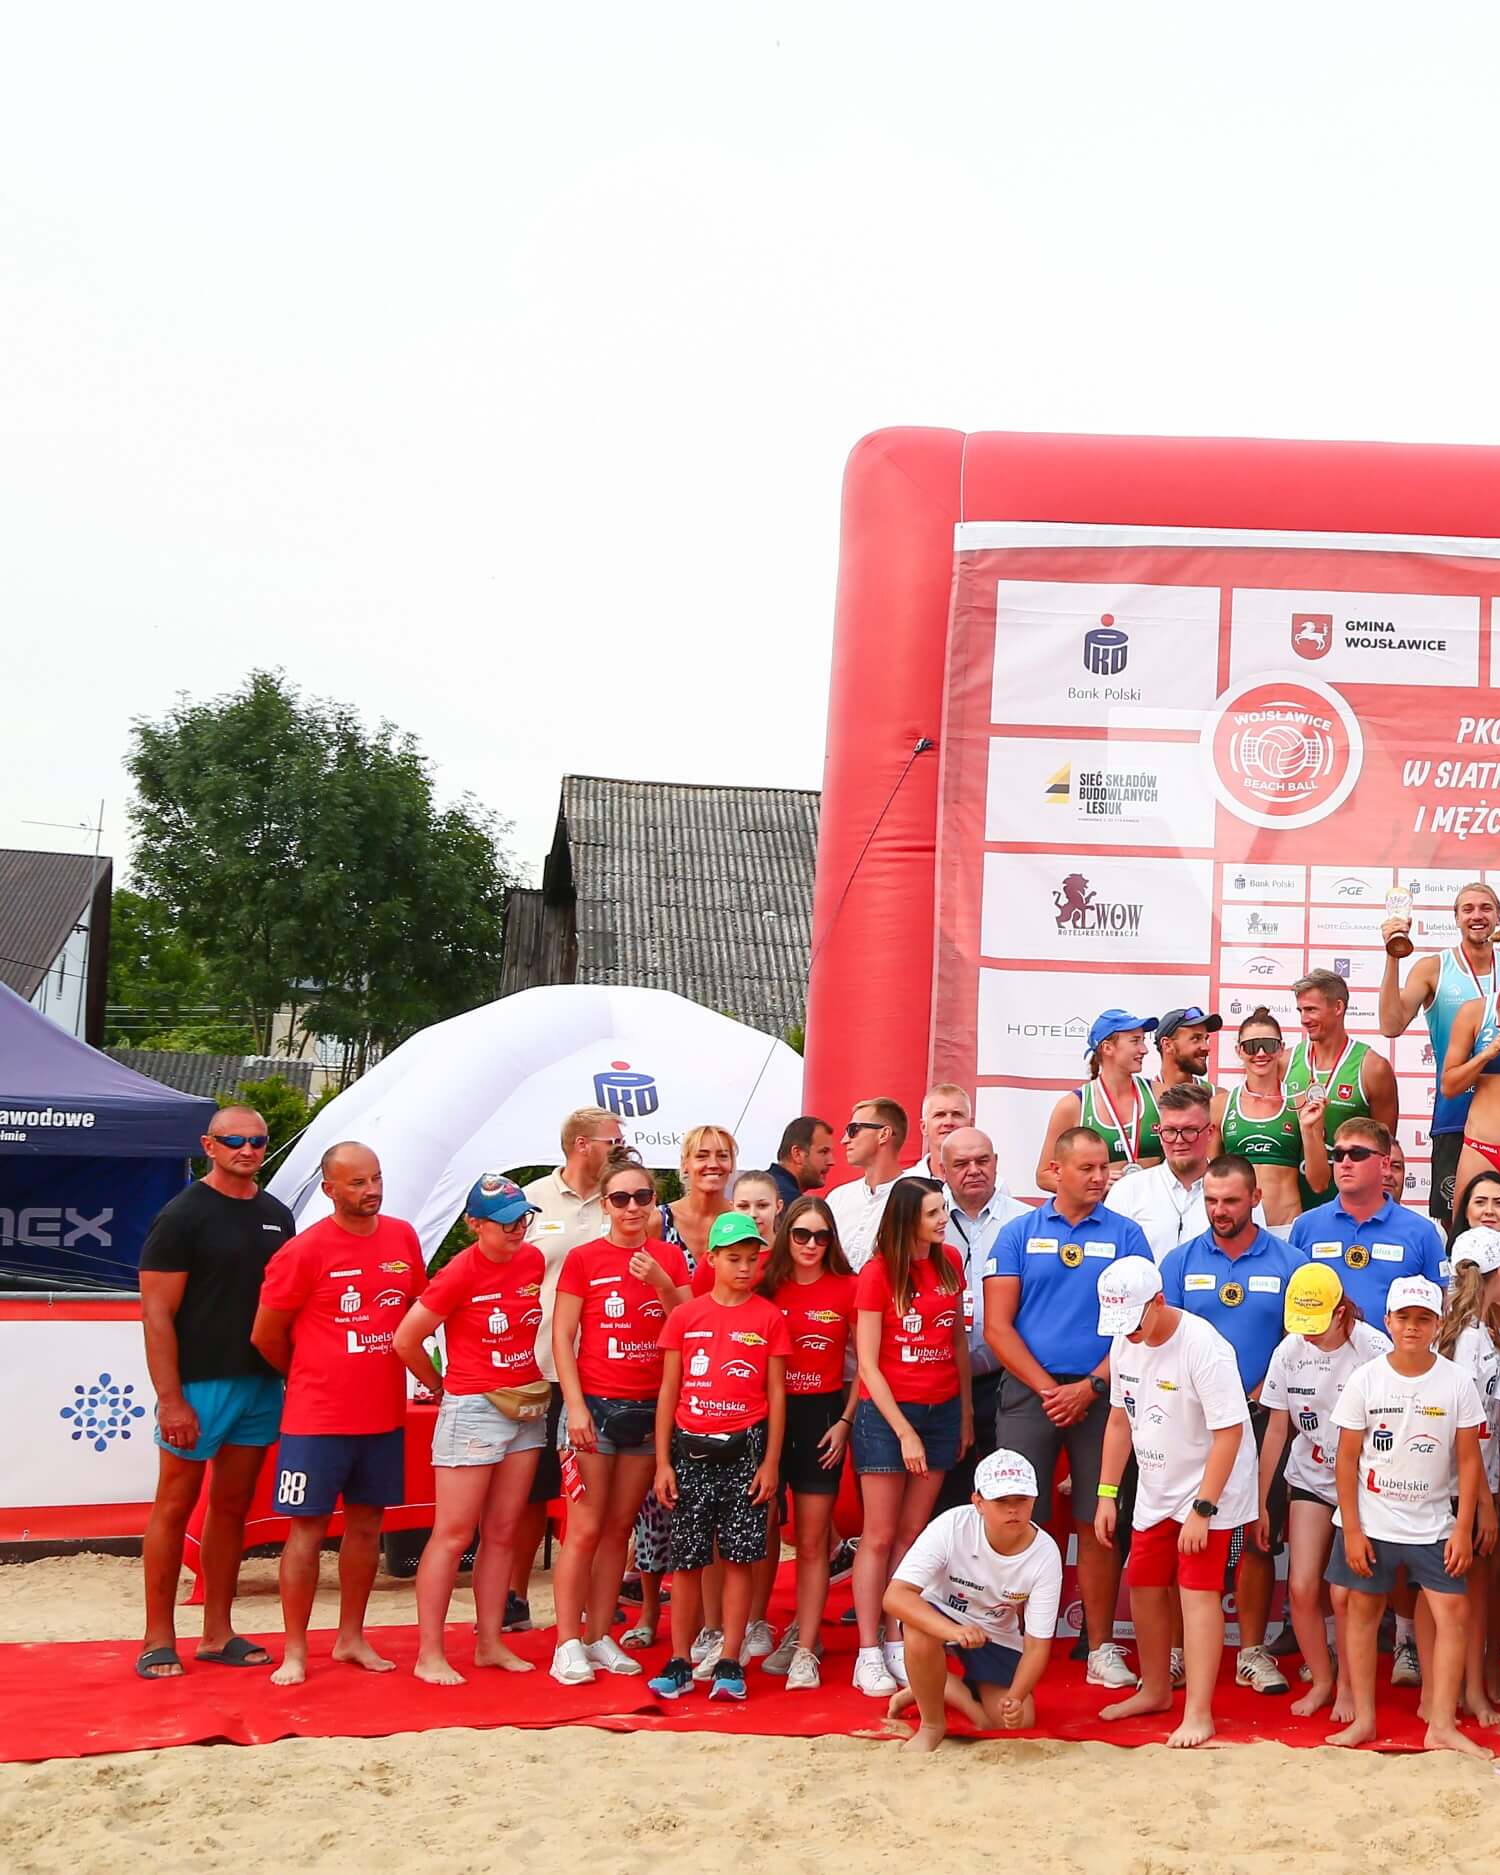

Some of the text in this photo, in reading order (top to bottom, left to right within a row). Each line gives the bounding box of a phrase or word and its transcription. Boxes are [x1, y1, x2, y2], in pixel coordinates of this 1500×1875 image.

[1345, 620, 1396, 633] GMINA
[1345, 637, 1447, 651] WOJSŁAWICE
[1068, 687, 1141, 701] Bank Polski
[1233, 711, 1333, 732] WOJSŁAWICE
[1079, 770, 1157, 788] SIEĆ SKŁADÓW
[1402, 761, 1431, 788] W
[1243, 778, 1318, 792] BEACH BALL
[1079, 787, 1159, 802] BUDOWLANYCH
[1086, 802, 1122, 815] LESIUK
[1413, 805, 1426, 833] I
[1250, 880, 1295, 889] Bank Polski
[1338, 886, 1364, 896] PGE
[1249, 965, 1275, 975] PGE
[1481, 1028, 1494, 1042] 2
[1227, 1109, 1237, 1120] 2
[1087, 1115, 1093, 1126] 1
[1245, 1143, 1273, 1153] PGE
[1402, 1288, 1431, 1297] FAST
[379, 1297, 401, 1308] PGE
[935, 1317, 954, 1328] PG
[802, 1341, 828, 1350] PGE
[727, 1367, 751, 1378] PGE
[1409, 1443, 1436, 1453] PGE
[994, 1468, 1022, 1478] FAST
[277, 1470, 306, 1506] 88
